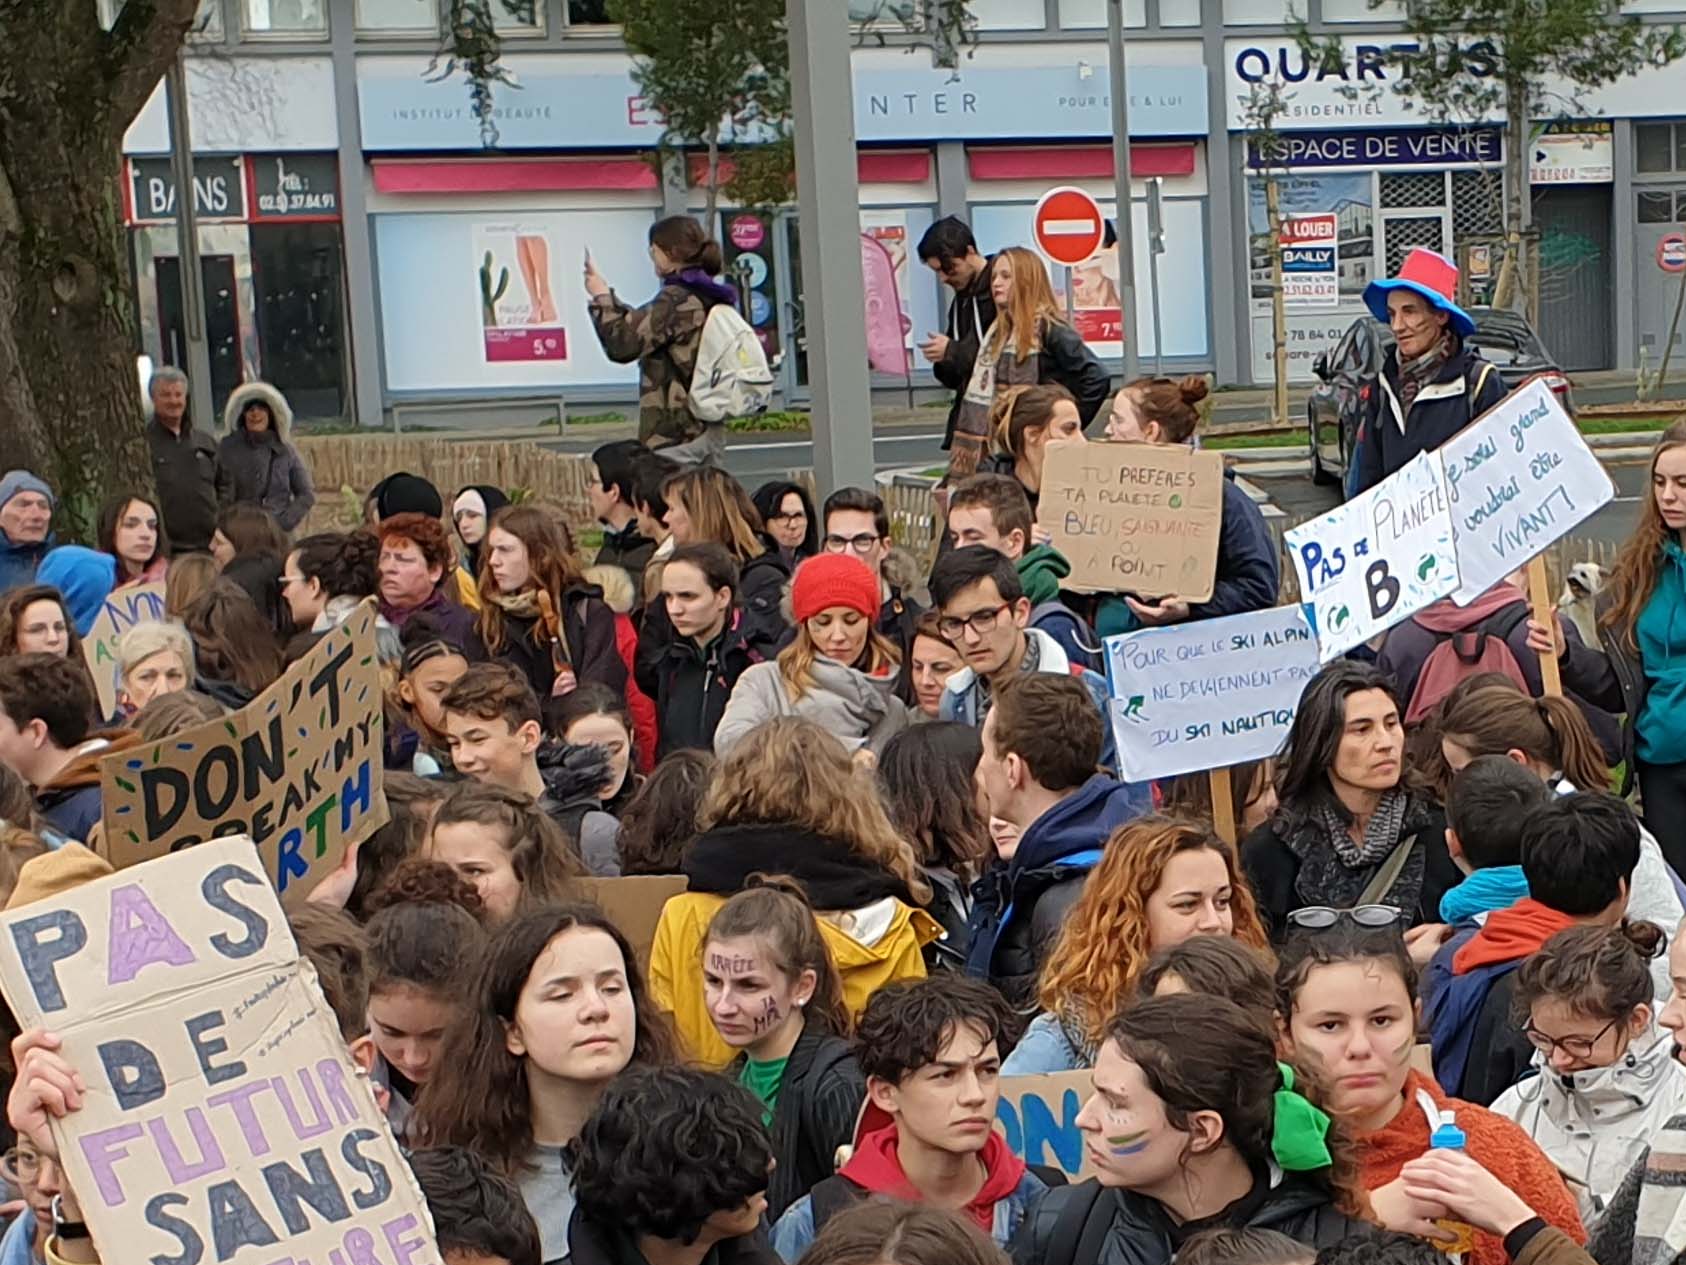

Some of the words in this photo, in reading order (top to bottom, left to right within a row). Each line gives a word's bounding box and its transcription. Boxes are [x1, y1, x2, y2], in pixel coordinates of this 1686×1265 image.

[1058, 96, 1096, 107] POUR
[1160, 95, 1183, 106] LUI
[1258, 138, 1357, 161] ESPACE
[1365, 136, 1398, 159] DE
[1407, 133, 1490, 157] VENTE
[1294, 221, 1333, 237] LOUER
[1283, 250, 1331, 263] BAILLY
[1063, 488, 1086, 503] TA
[1111, 555, 1167, 580] POINT
[1300, 541, 1347, 592] PAS
[1354, 538, 1369, 557] DE
[1364, 558, 1401, 621] B
[1118, 640, 1170, 671] POUR
[1177, 643, 1205, 662] QUE
[1230, 634, 1256, 651] SKI
[1263, 627, 1310, 647] ALPIN
[1152, 682, 1175, 700] NE
[142, 641, 353, 843] DON'T
[334, 711, 372, 773] MY
[1151, 727, 1178, 747] DU
[1186, 723, 1210, 741] SKI
[9, 863, 270, 1013] PAS
[97, 1009, 248, 1111] DE
[79, 1057, 360, 1208] FUTUR
